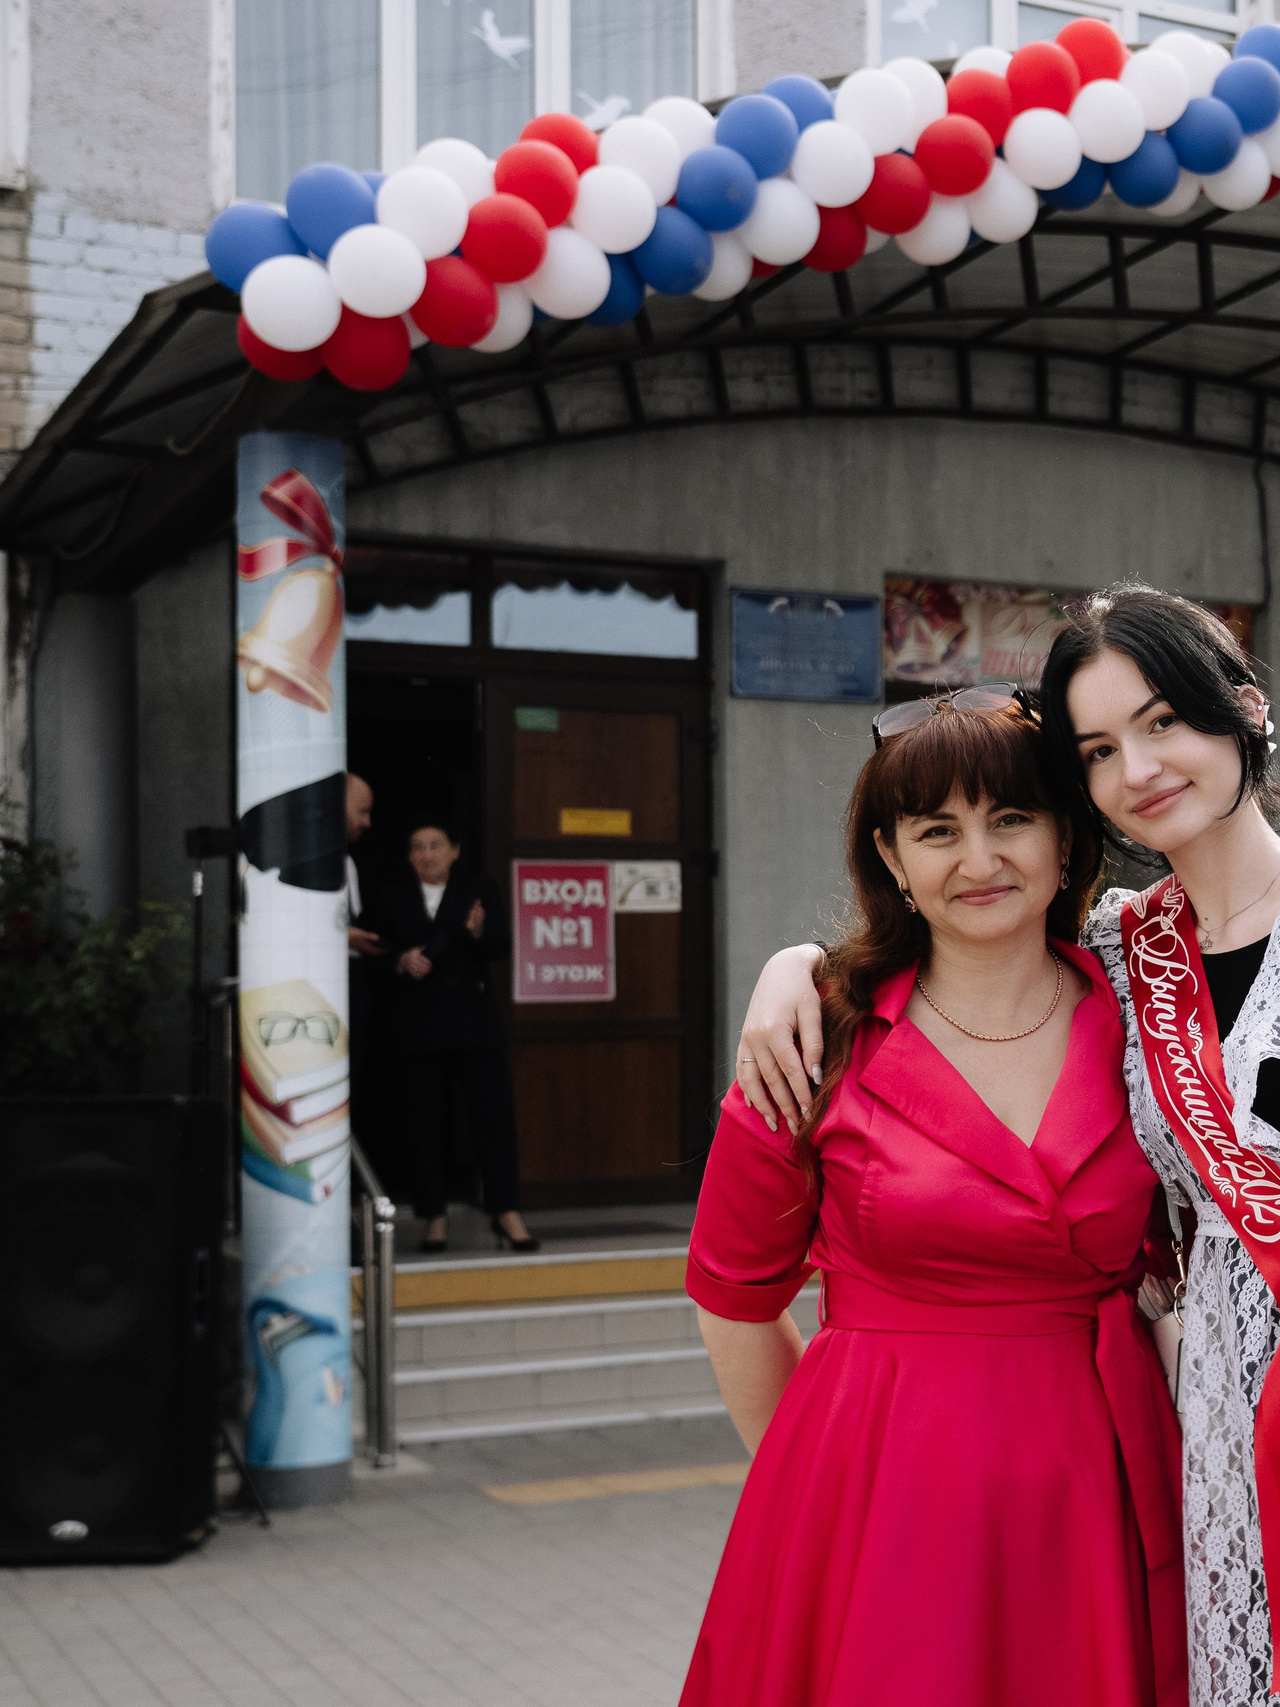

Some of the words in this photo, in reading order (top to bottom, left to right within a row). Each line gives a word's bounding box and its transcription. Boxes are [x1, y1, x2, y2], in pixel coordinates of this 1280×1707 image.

[523, 879, 605, 907] ВХОД
[533, 916, 594, 948] №1
[527, 963, 536, 982] 1
[542, 964, 604, 983] этаж
[1130, 915, 1240, 1164] Выпускница
